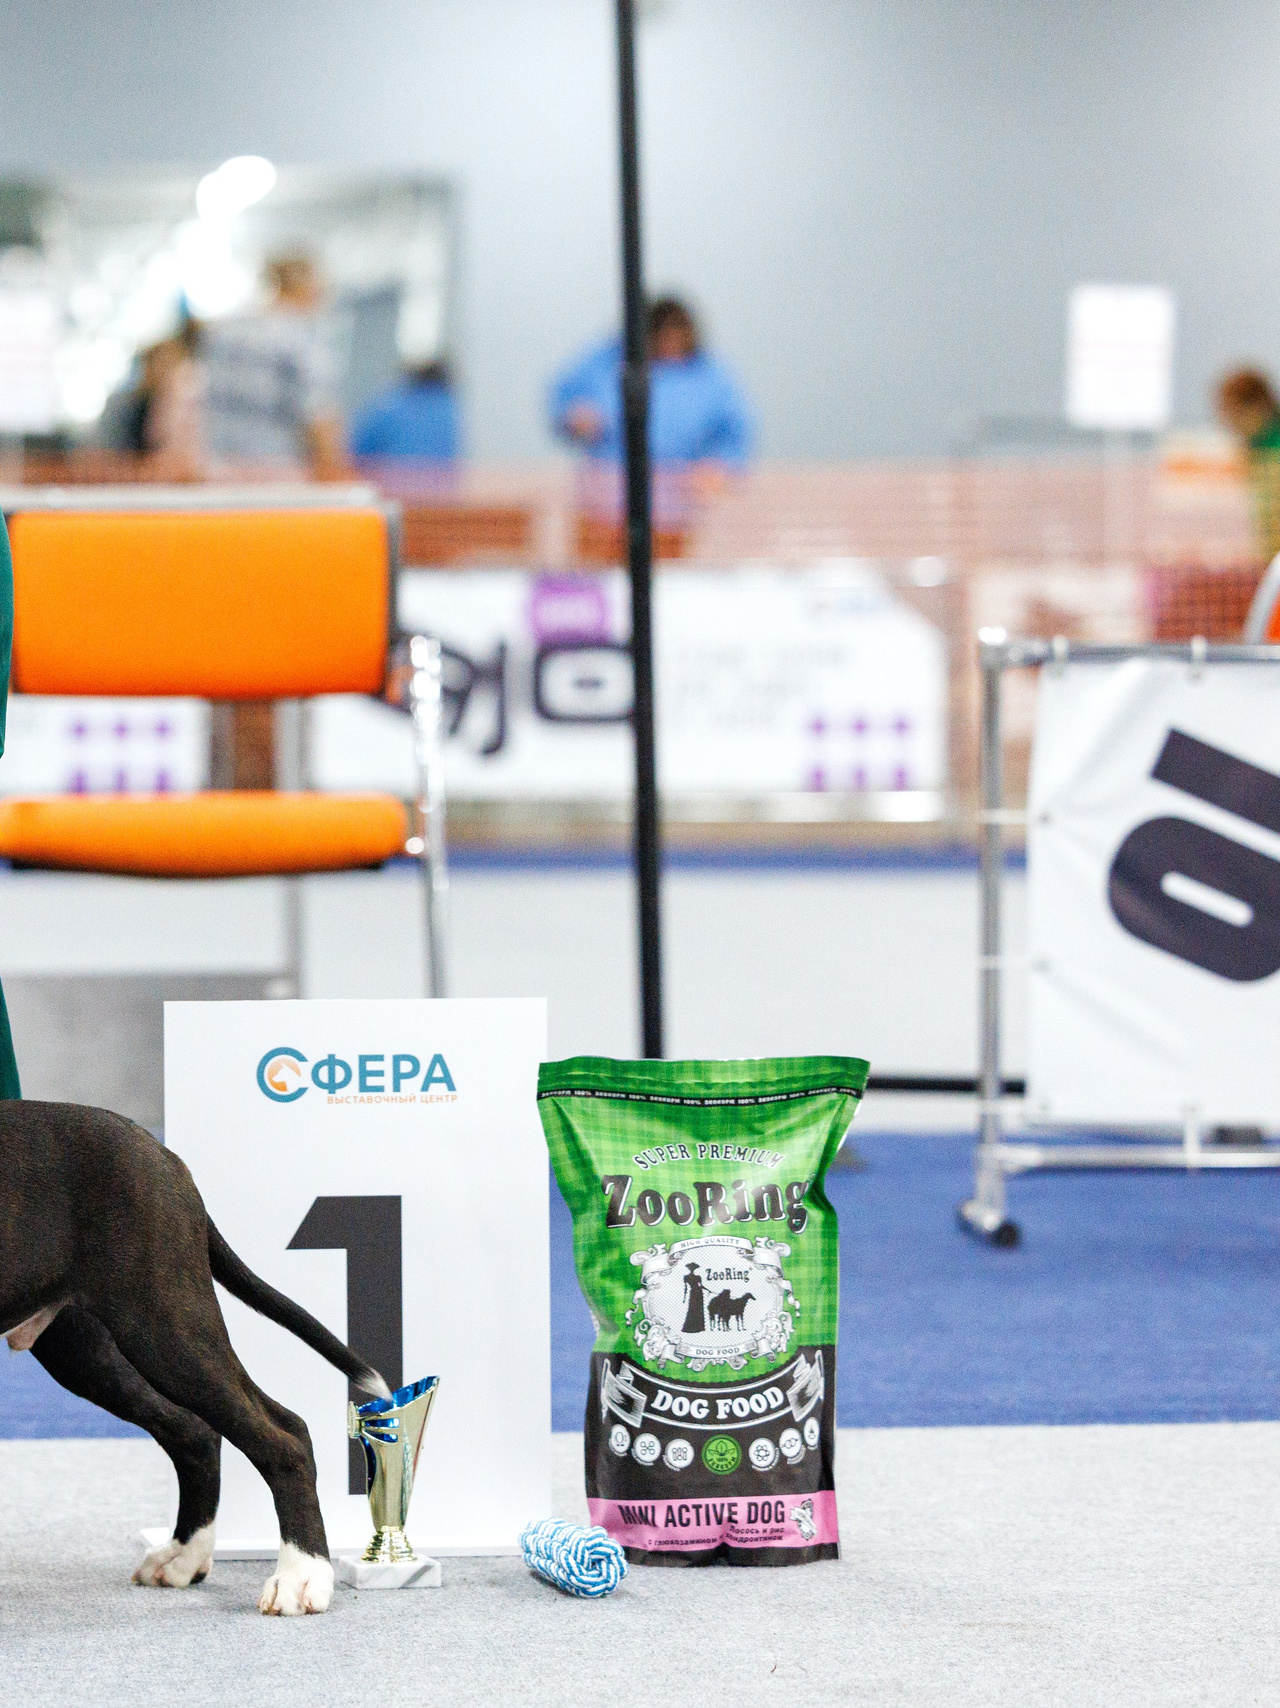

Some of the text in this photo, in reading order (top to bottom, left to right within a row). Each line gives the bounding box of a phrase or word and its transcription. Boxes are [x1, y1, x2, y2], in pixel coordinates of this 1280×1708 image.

[256, 1046, 457, 1103] СФЕРА
[327, 1094, 459, 1104] ВЫСТАВОЧНЫЙ ЦЕНТР
[633, 1143, 785, 1170] SUPER PREMIUM
[602, 1174, 809, 1234] ZooRing
[705, 1267, 749, 1282] ZooRing
[286, 1195, 403, 1495] 1
[651, 1386, 785, 1420] DOG FOOD
[664, 1502, 739, 1527] ACTIVE
[747, 1500, 785, 1524] DOG
